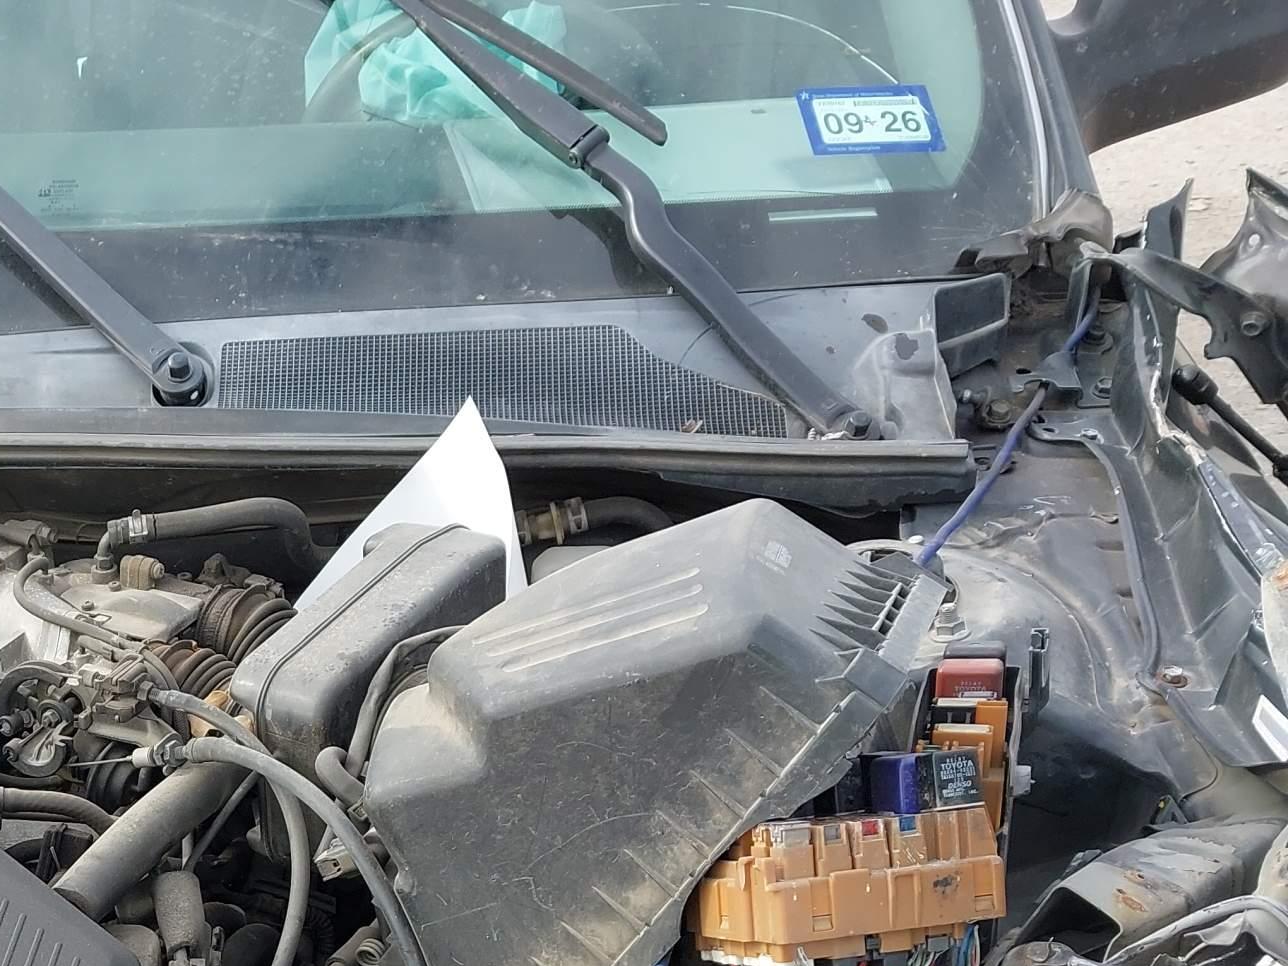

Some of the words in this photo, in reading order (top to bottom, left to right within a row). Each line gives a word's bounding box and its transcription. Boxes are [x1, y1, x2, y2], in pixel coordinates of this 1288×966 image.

[823, 112, 864, 135] 09
[880, 110, 922, 133] 26
[941, 760, 974, 771] TOYOTA
